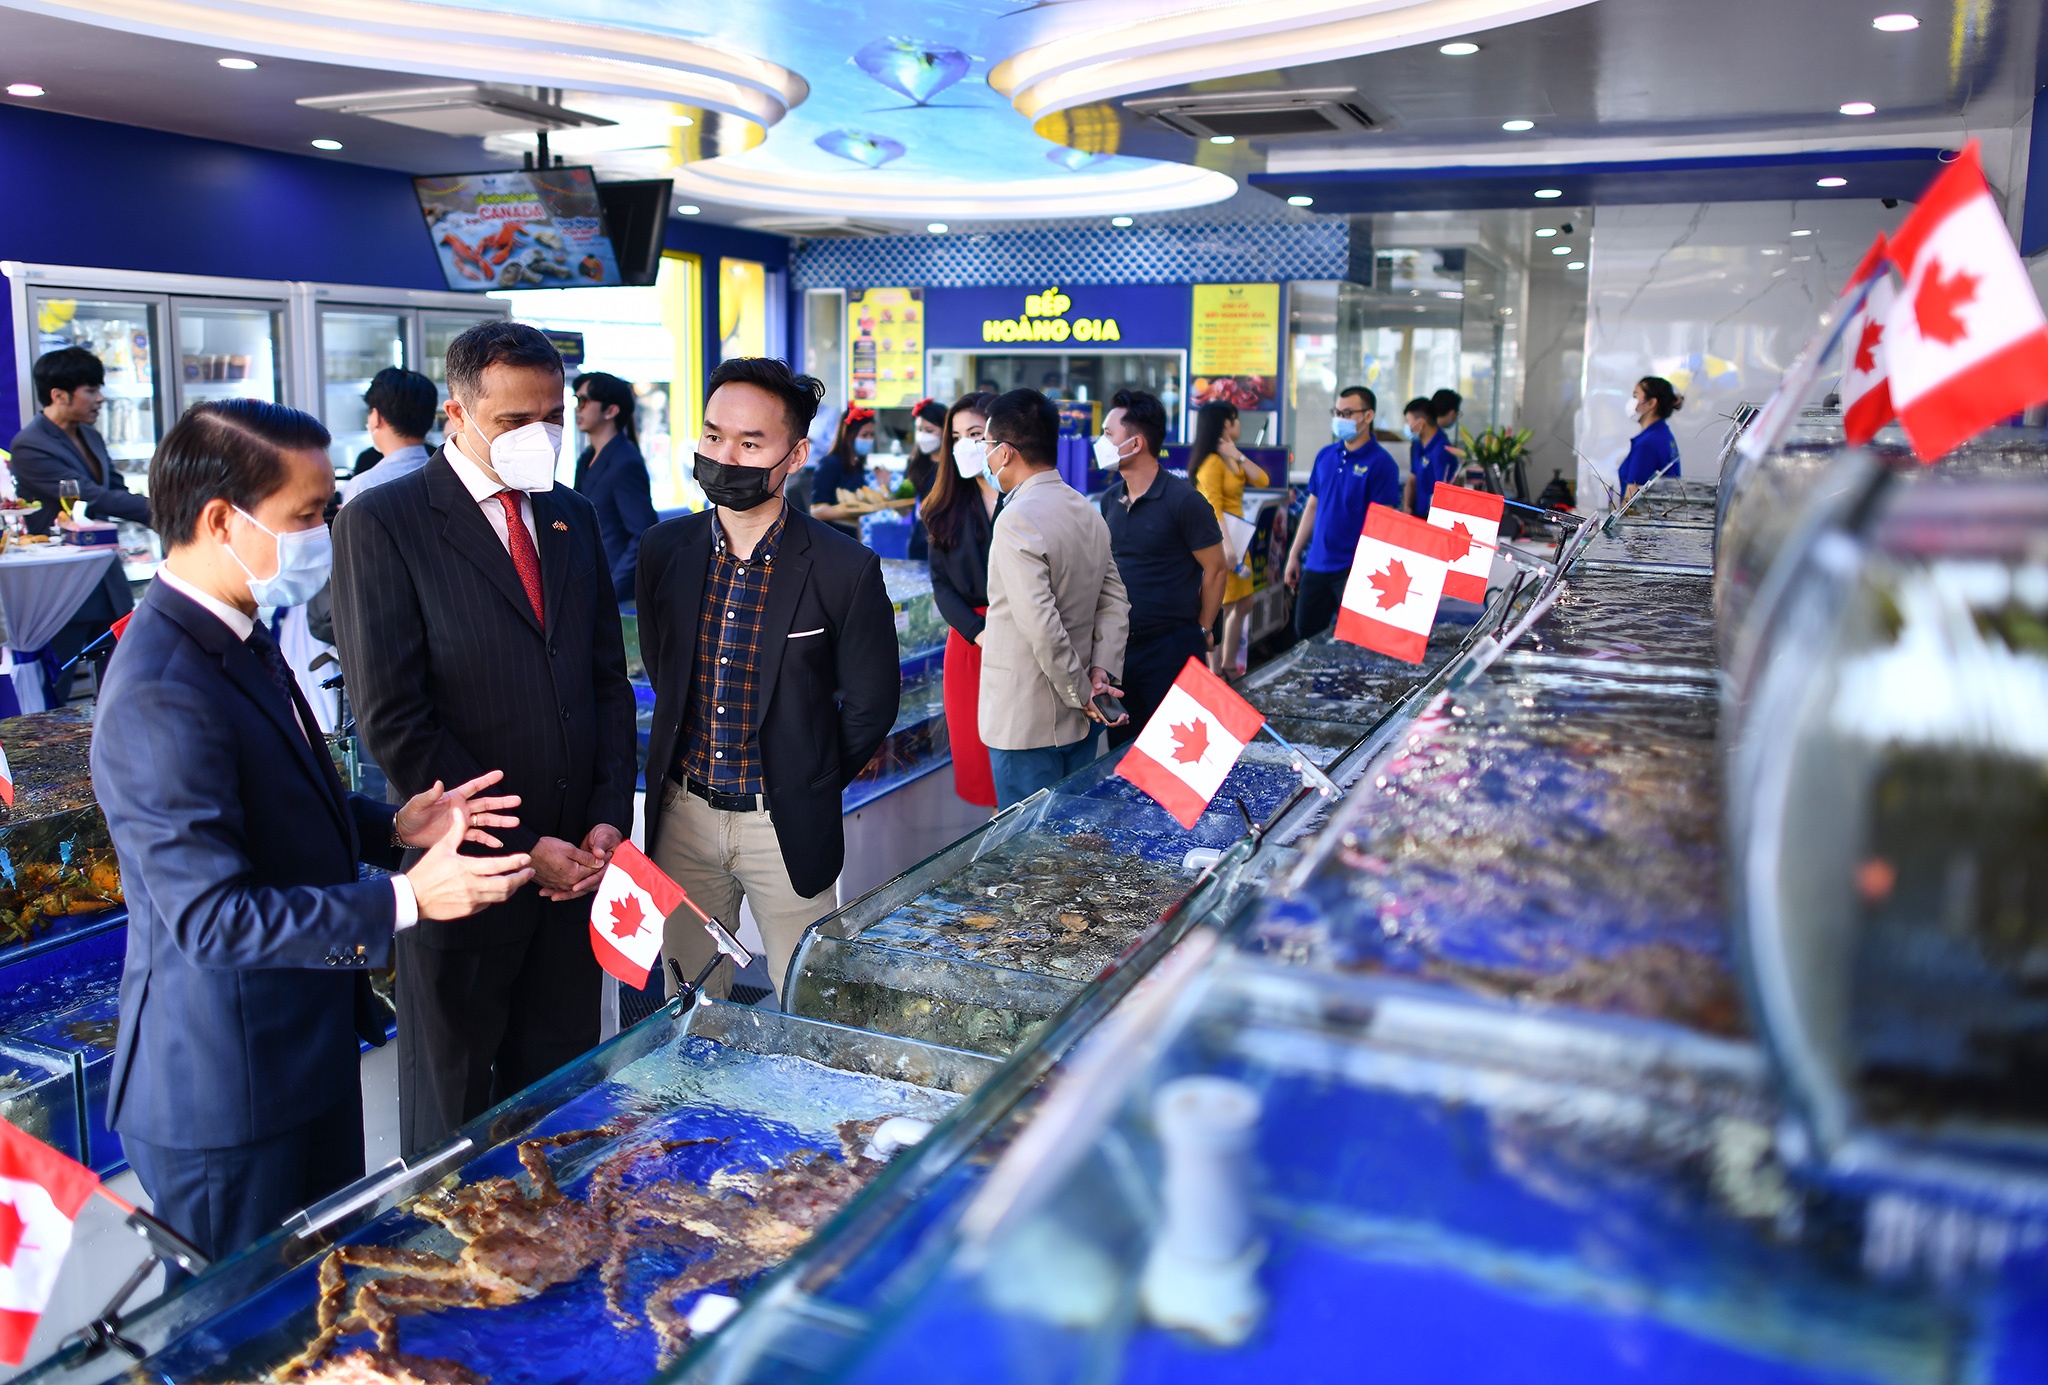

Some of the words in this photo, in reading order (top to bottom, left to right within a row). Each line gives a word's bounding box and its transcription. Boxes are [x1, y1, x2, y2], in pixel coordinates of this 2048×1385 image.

[478, 204, 545, 220] CANADA
[1025, 286, 1071, 317] BẾP
[983, 314, 1071, 342] HOÀNG
[1072, 318, 1120, 342] GIA
